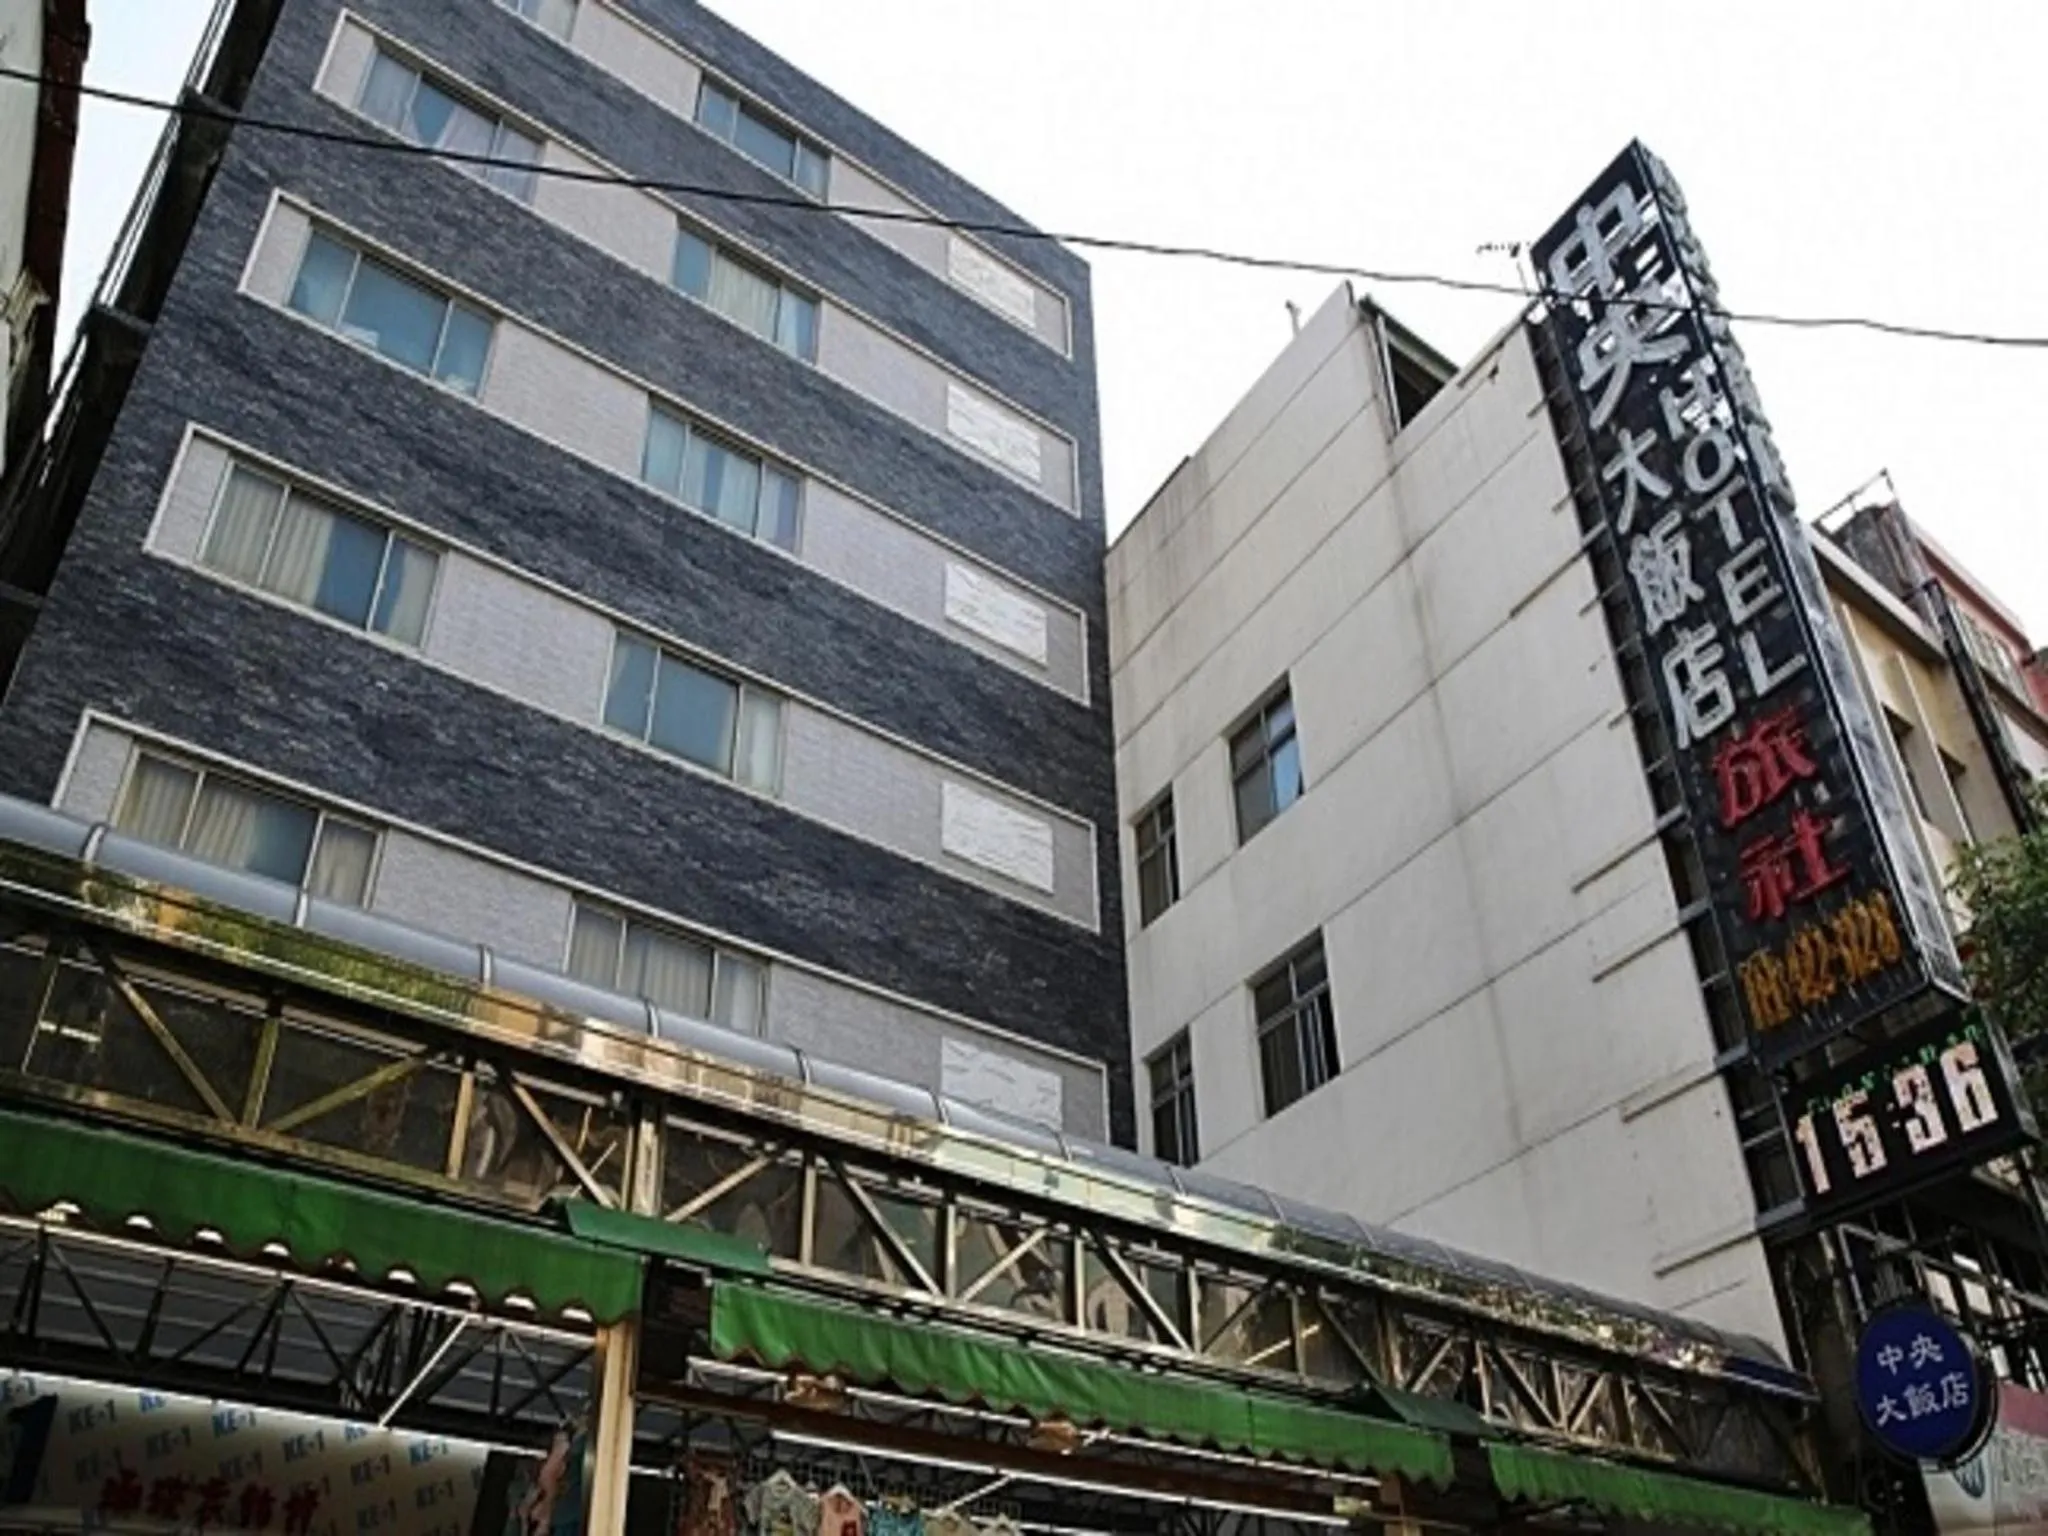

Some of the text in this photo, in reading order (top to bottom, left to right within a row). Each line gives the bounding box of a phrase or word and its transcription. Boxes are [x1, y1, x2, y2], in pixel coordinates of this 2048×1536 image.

[1658, 350, 1808, 698] HOTEL
[1711, 704, 1853, 922] 旅社
[1796, 1040, 1999, 1195] 15:36
[1876, 1331, 1944, 1376] 中央
[1876, 1371, 1969, 1427] 大飯店
